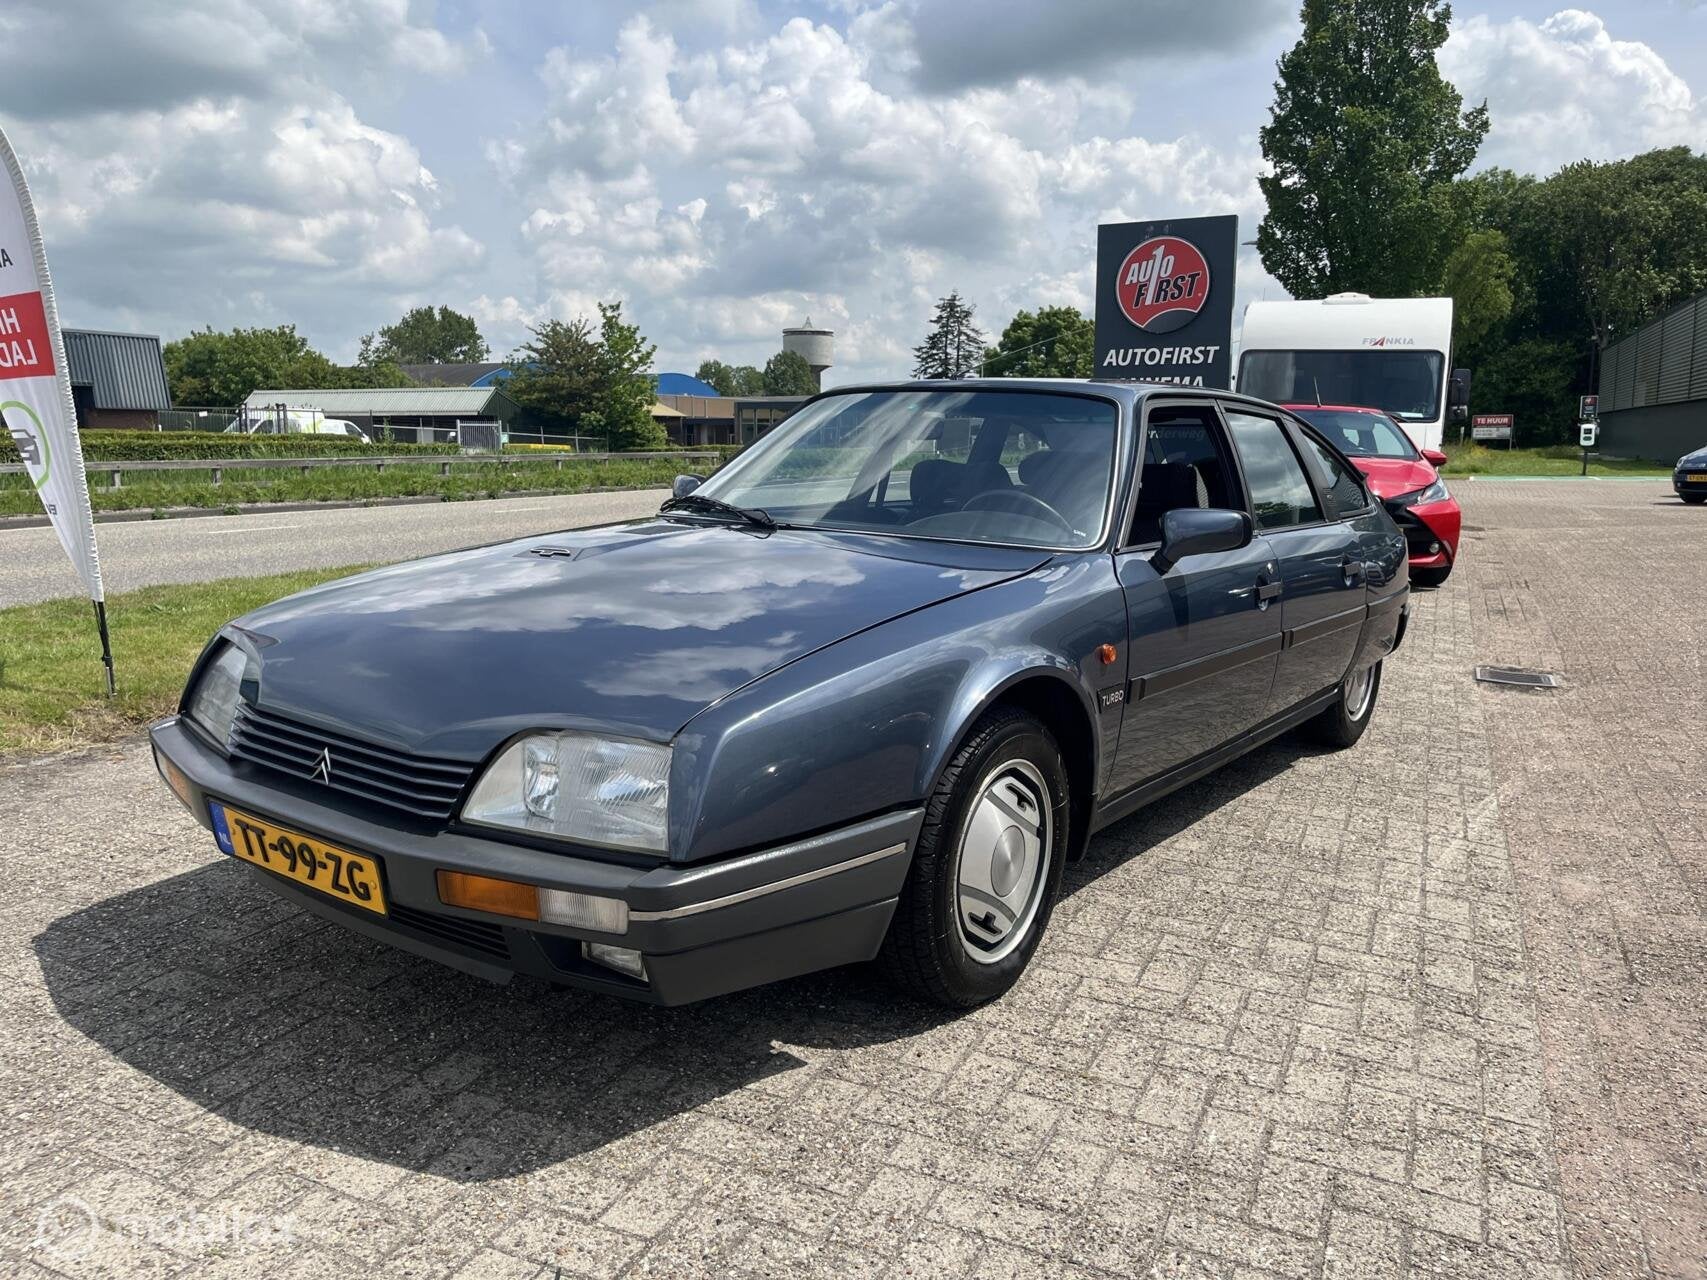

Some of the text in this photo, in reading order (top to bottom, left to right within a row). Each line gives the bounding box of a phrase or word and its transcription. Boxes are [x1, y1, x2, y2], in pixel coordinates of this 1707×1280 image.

[1362, 336, 1414, 347] FRANKIA
[1103, 346, 1220, 366] AUTOFIRST
[1477, 417, 1509, 425] TE HUUR
[1102, 690, 1125, 706] TURBO
[234, 818, 371, 901] TT-99-ZG
